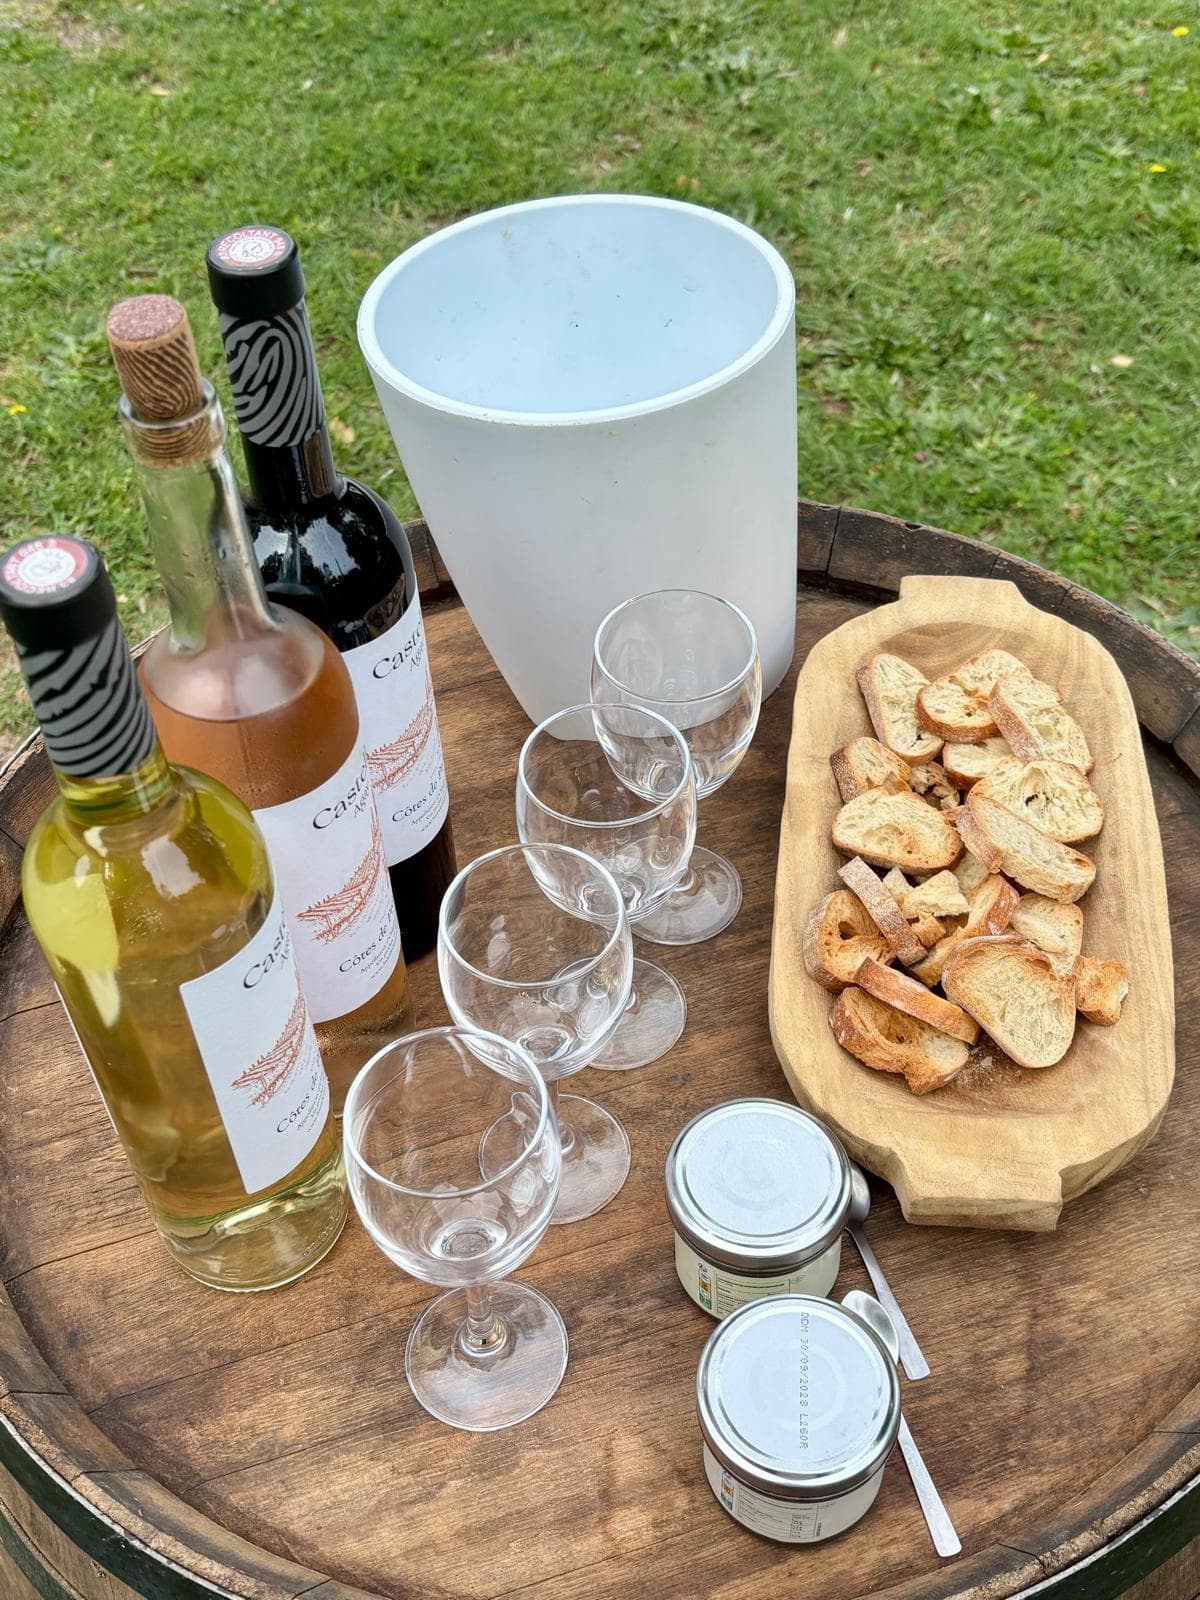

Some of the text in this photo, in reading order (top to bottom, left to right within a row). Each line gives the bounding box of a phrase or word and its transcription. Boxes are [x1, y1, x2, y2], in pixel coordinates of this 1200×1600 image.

[392, 796, 427, 822] Côtes
[340, 943, 377, 972] Côtes
[277, 1092, 310, 1133] Côtes
[799, 1311, 809, 1449] DDM 30/09/2028 L260R
